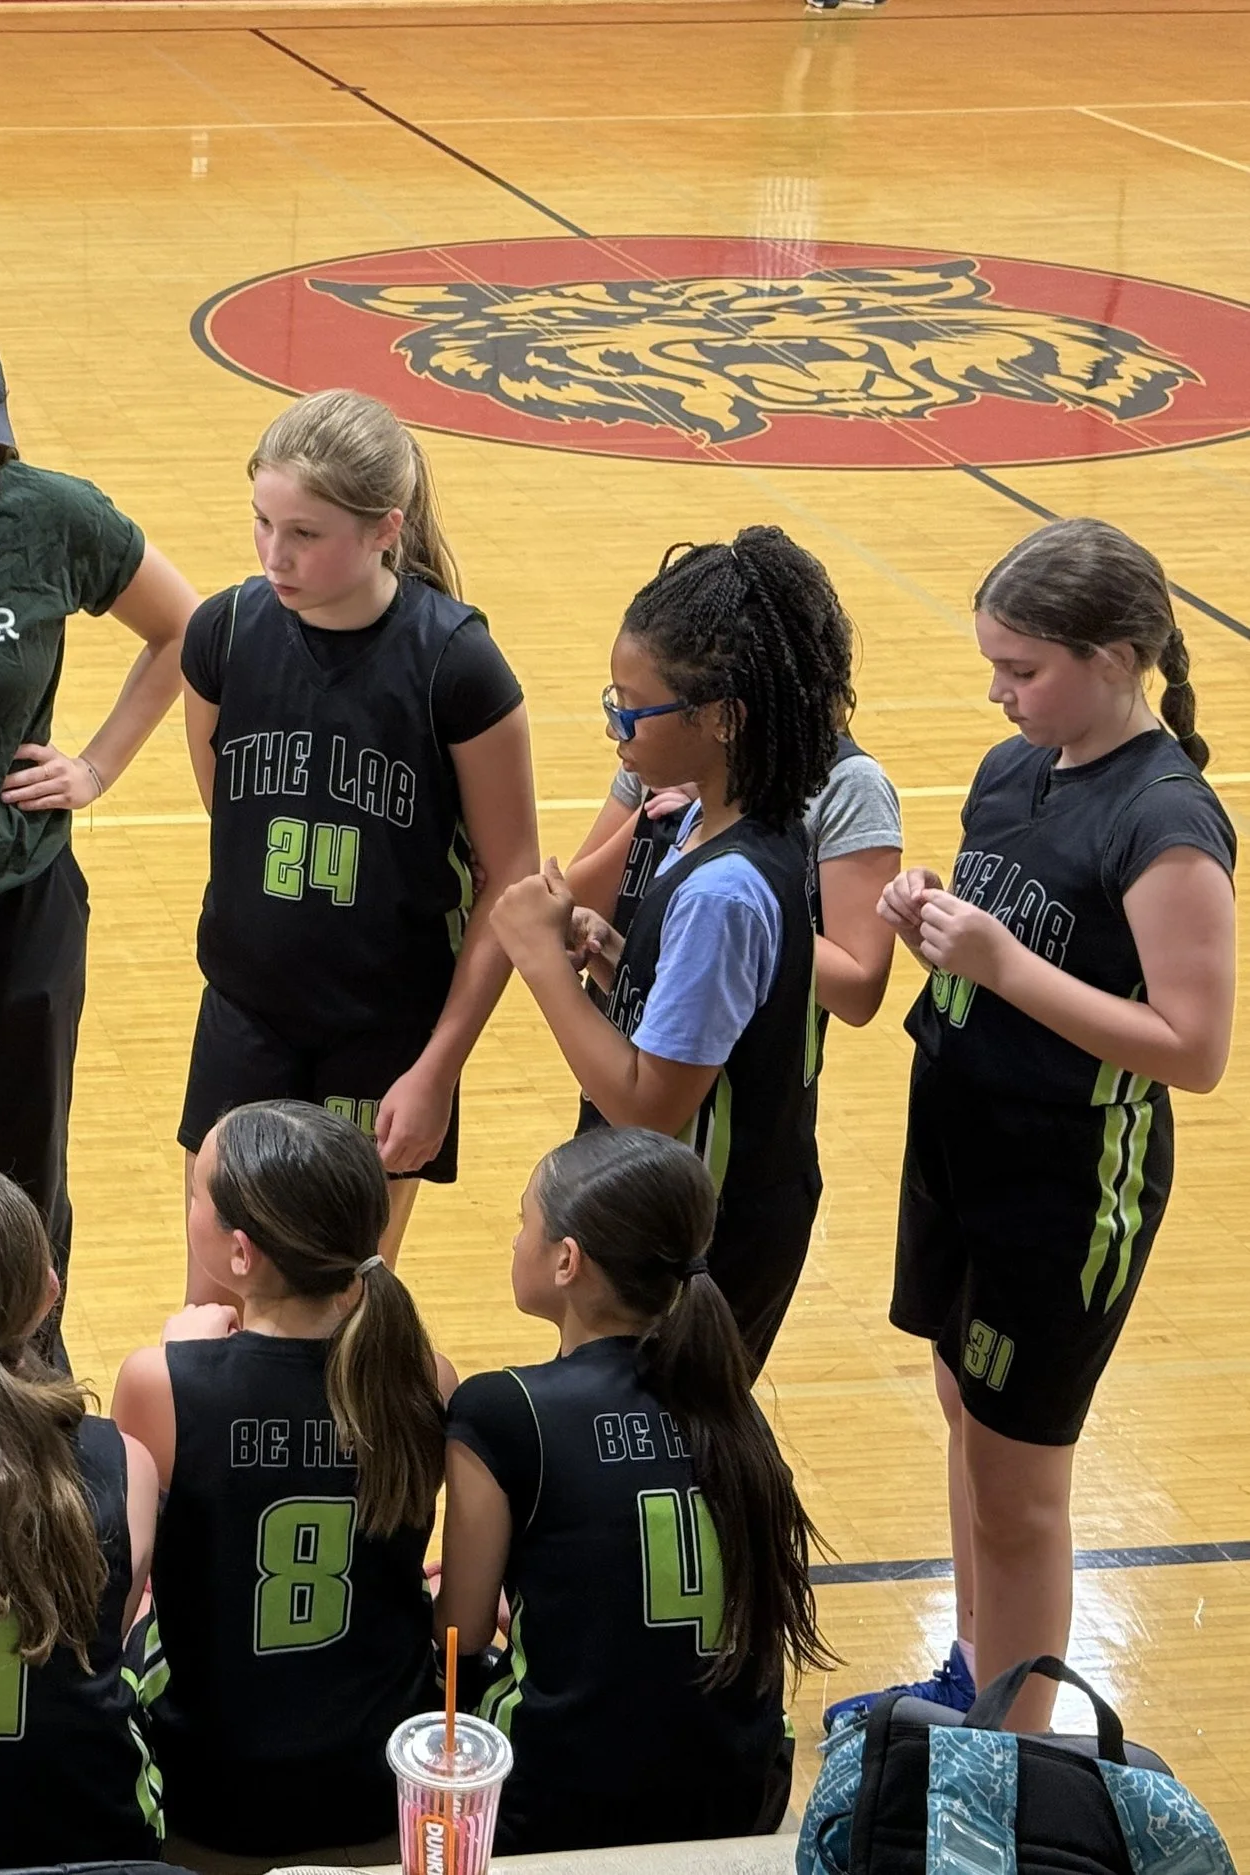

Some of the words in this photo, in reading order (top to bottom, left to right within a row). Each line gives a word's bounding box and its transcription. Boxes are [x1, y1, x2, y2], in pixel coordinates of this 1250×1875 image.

[222, 731, 312, 801] THE
[328, 735, 416, 828] LAB
[263, 816, 360, 906] 24
[963, 1319, 1015, 1392] 31
[231, 1418, 289, 1467] BE
[593, 1412, 655, 1462] BE
[254, 1496, 358, 1656] 8
[637, 1486, 737, 1656] 4
